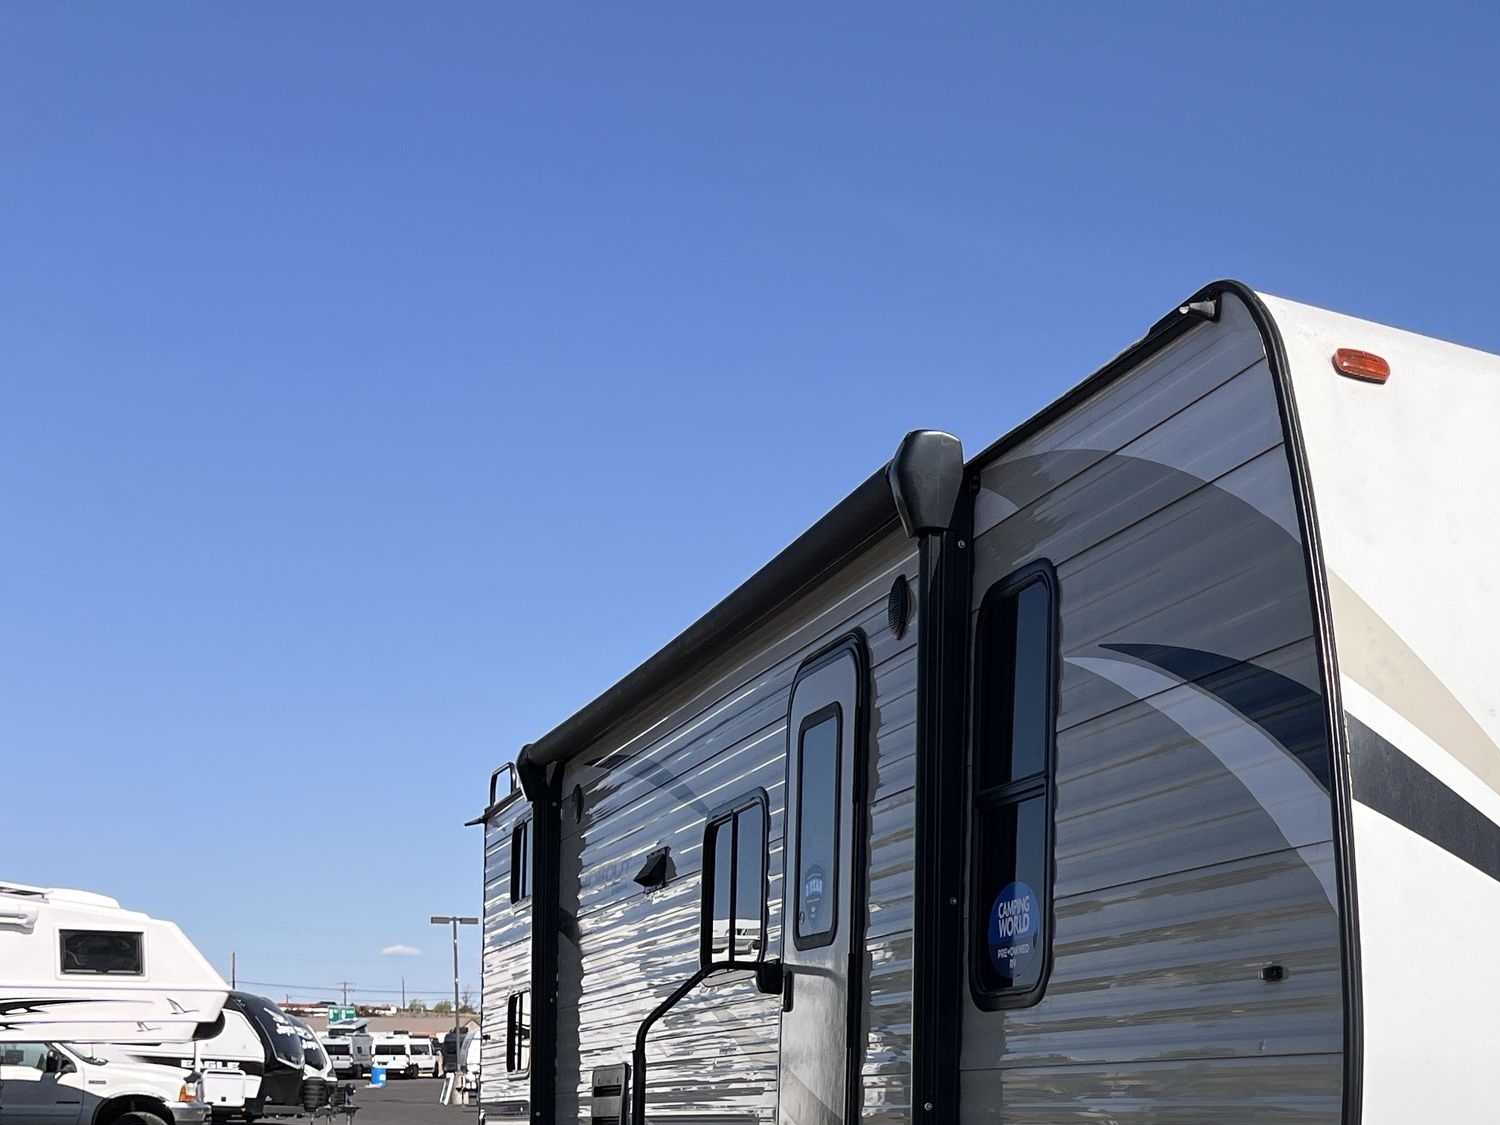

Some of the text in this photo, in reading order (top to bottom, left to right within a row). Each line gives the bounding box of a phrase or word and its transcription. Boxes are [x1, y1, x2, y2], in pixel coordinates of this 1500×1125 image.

[998, 896, 1030, 918] CAMPING
[998, 914, 1030, 938] WORLD
[1009, 959, 1017, 968] RV
